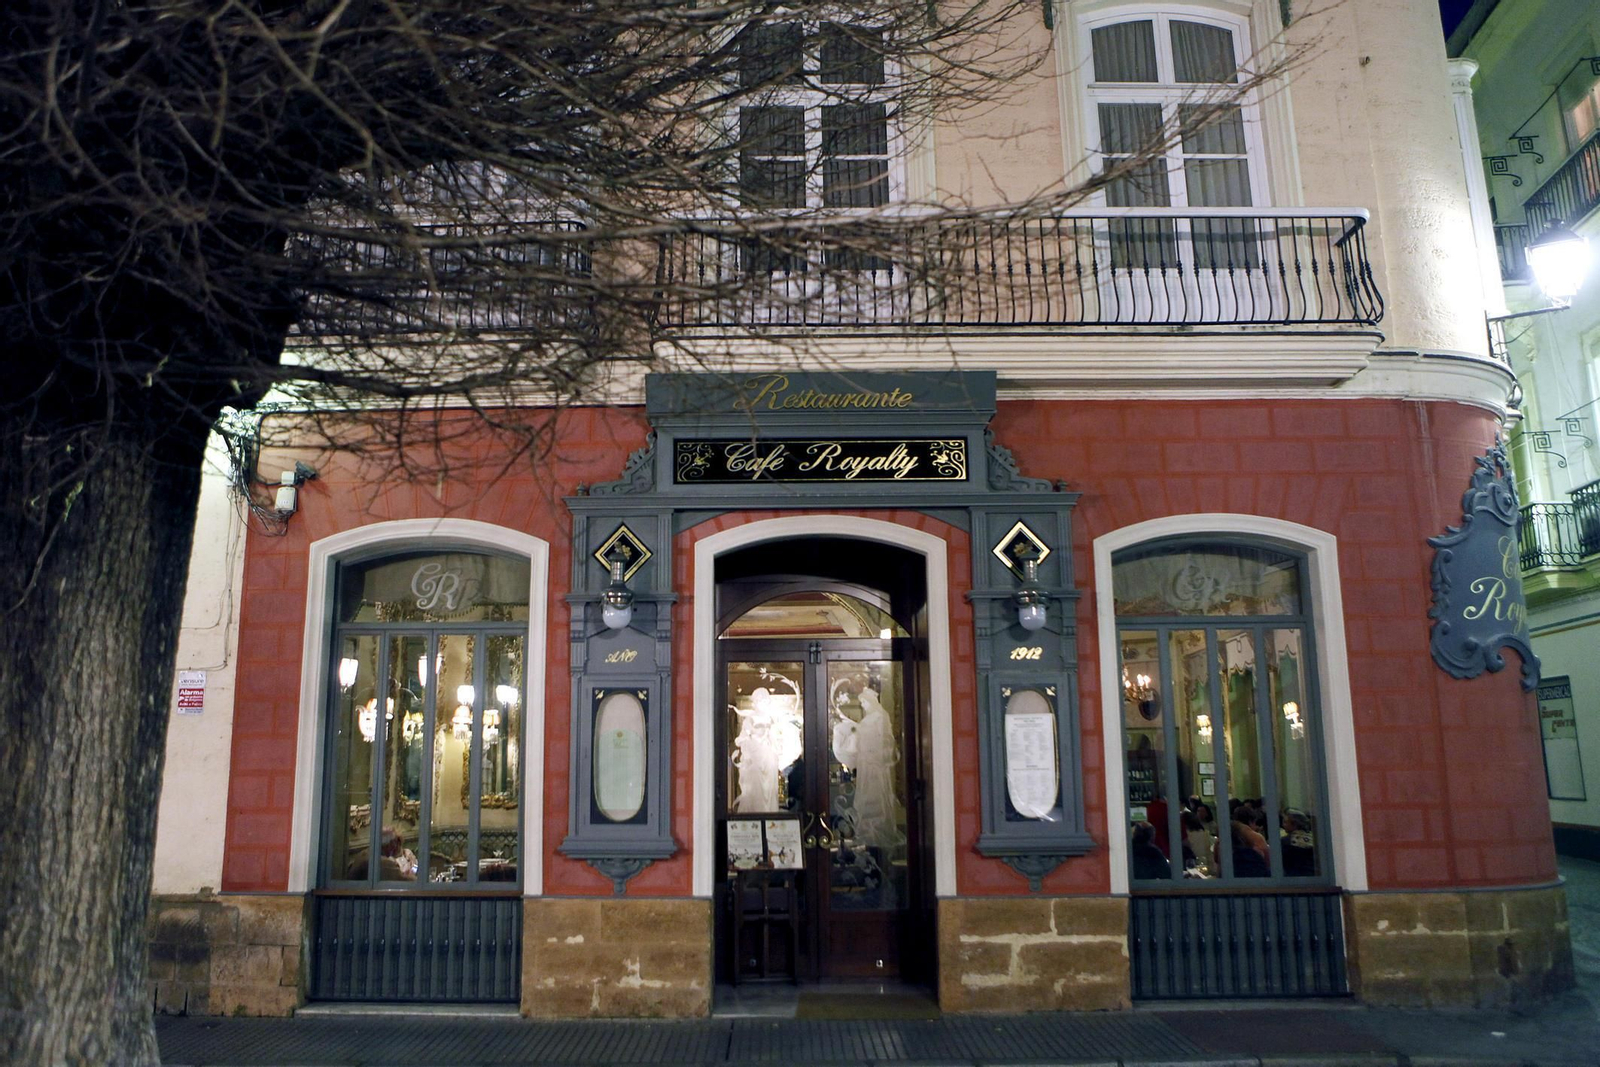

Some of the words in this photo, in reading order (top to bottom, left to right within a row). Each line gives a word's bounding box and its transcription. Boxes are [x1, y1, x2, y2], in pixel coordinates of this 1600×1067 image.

[733, 374, 914, 411] Restaurante
[725, 443, 790, 480] Café
[798, 442, 920, 480] Royalty
[1009, 646, 1043, 660] 1912
